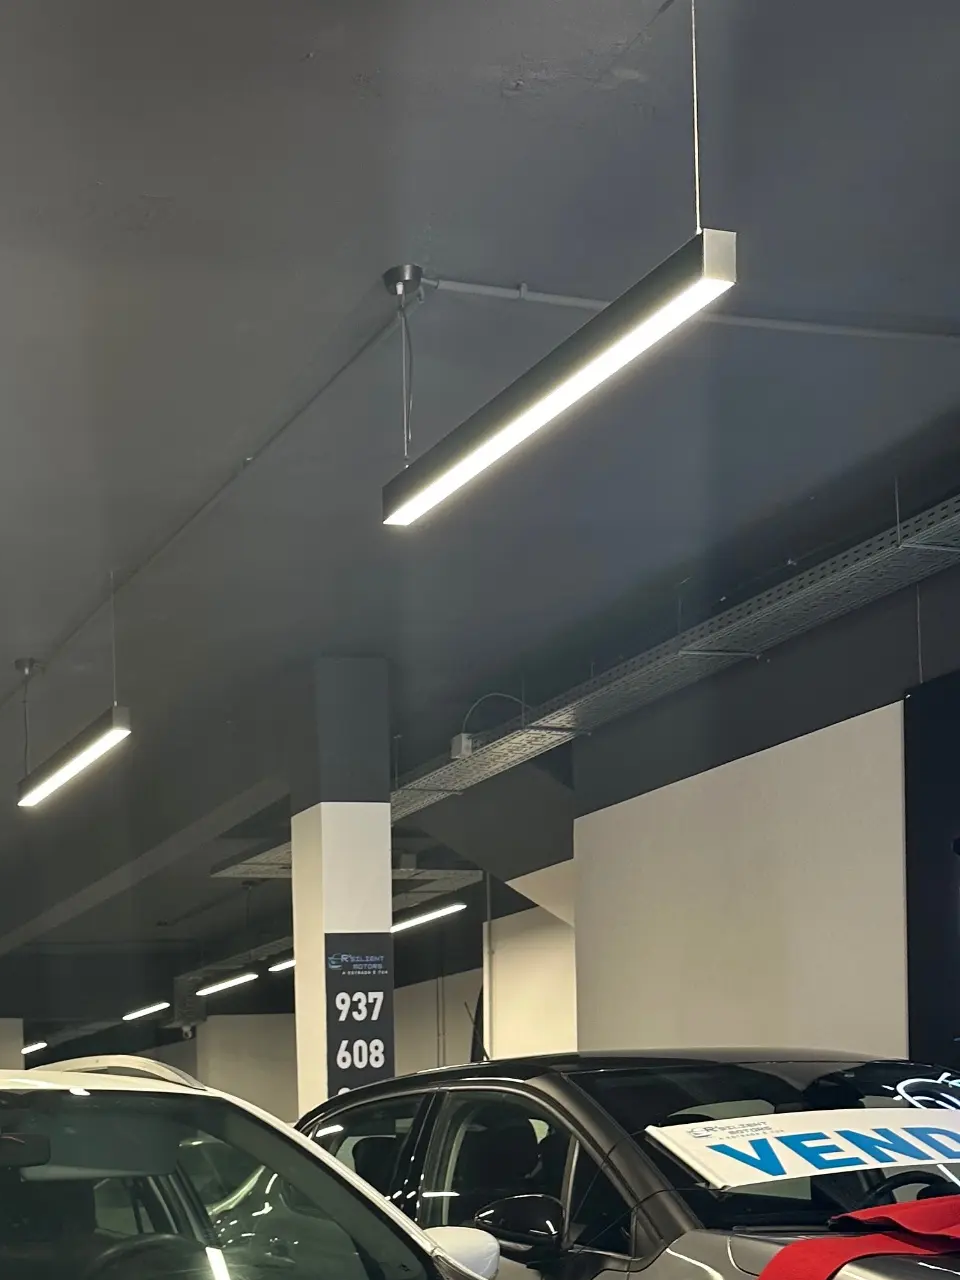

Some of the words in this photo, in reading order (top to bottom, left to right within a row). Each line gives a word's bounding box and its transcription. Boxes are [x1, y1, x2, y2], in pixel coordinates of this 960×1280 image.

[335, 991, 384, 1022] 937
[336, 1038, 385, 1069] 608
[705, 1127, 960, 1177] VEND
